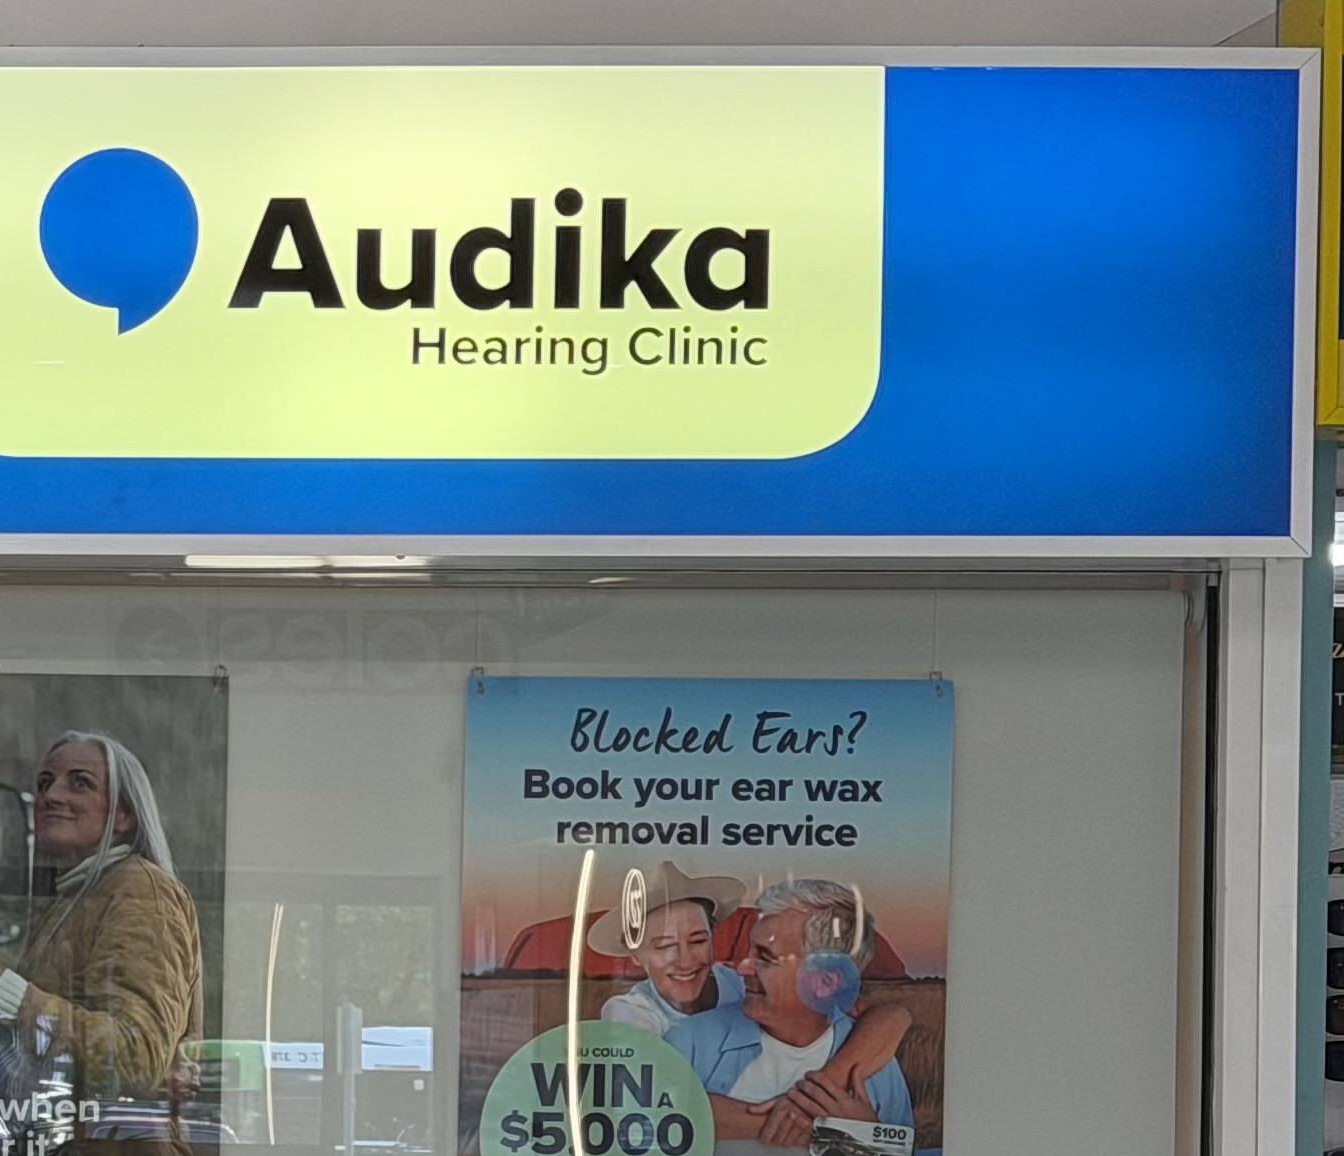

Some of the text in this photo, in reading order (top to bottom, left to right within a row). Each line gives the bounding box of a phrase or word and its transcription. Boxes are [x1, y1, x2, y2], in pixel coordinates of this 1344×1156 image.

[228, 187, 769, 309] Audika
[412, 326, 768, 375] Hearing Clinic
[570, 707, 867, 756] Blocked Ears?
[523, 769, 883, 808] Book your ear wax
[557, 815, 858, 847] removal service
[591, 1048, 635, 1058] COULD
[531, 1063, 674, 1108] WIN A
[873, 1126, 907, 1140] $100
